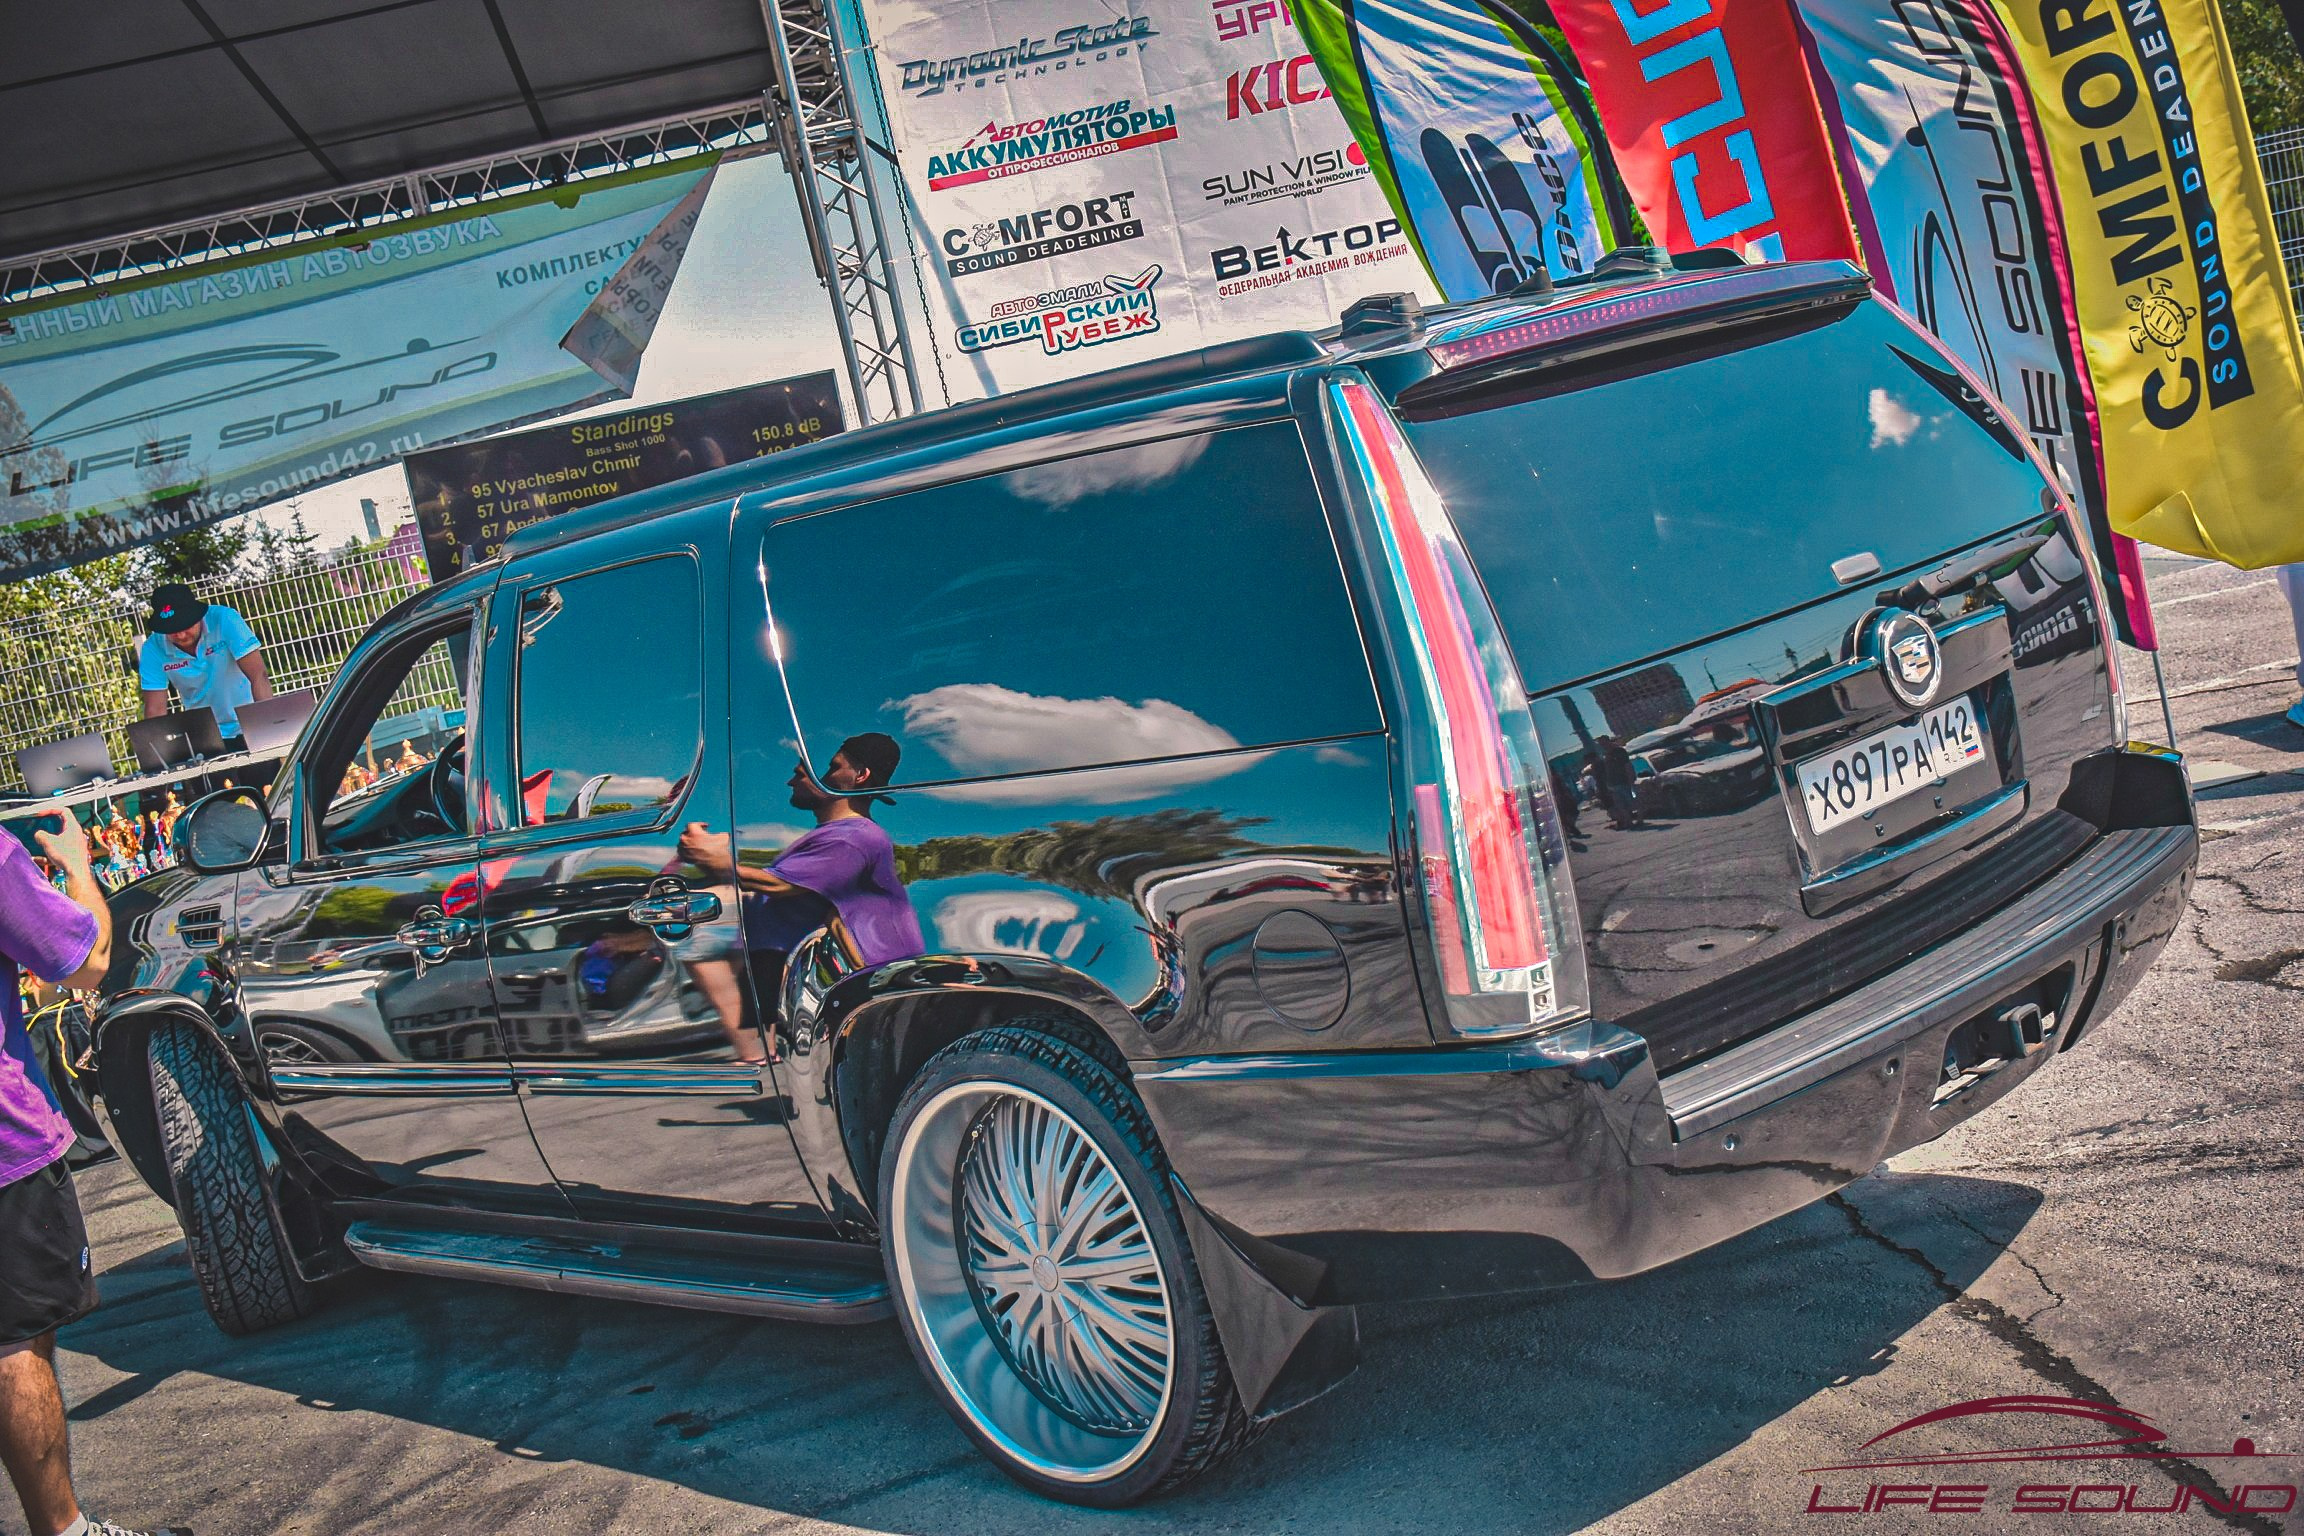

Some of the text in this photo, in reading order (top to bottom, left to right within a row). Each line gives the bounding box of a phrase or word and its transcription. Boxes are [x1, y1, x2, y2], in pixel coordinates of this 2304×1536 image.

[896, 15, 1160, 98] Dynamic State
[954, 43, 1148, 92] TECHNOLOGY
[1227, 54, 1332, 120] KIC
[928, 104, 1177, 178] АККУМУЛЯТОРЫ
[987, 142, 1120, 179] ОТ ПРОФЕССИОНАЛОВ
[1202, 165, 1274, 200] SUN
[1224, 193, 1249, 206] PAINT
[1251, 182, 1305, 199] PROTECTION
[1314, 170, 1354, 186] WINDOW
[1293, 187, 1323, 199] WORLD
[128, 263, 293, 318] МАГАЗИН
[302, 217, 502, 282] АВТОЗВУКА
[496, 234, 648, 288] КОМПЛЕКТУ
[956, 225, 1135, 274] SOUND DEADENING
[1218, 244, 1408, 297] ФЕДЕРАЛЬНАЯ АКАДЕМИЯ ВОЖДЕНИЯ
[991, 281, 1102, 318] АВТОЭМАЛИ
[2194, 219, 2240, 386] SOUND
[9, 351, 498, 497] LIFE SOUND
[571, 411, 675, 444] Standings
[585, 433, 666, 457] Bass Shot 1000
[471, 481, 492, 499] 95
[496, 464, 588, 496] Vyacheslav
[592, 454, 642, 475] Chmir
[752, 422, 794, 443] 150.8
[798, 417, 821, 433] dB
[97, 430, 425, 549] www.lifesound42.ru
[441, 481, 618, 526] 2. 57 Ura Mamontov
[446, 532, 461, 546] 3.
[481, 523, 500, 539] 67
[1929, 705, 1973, 752] 142
